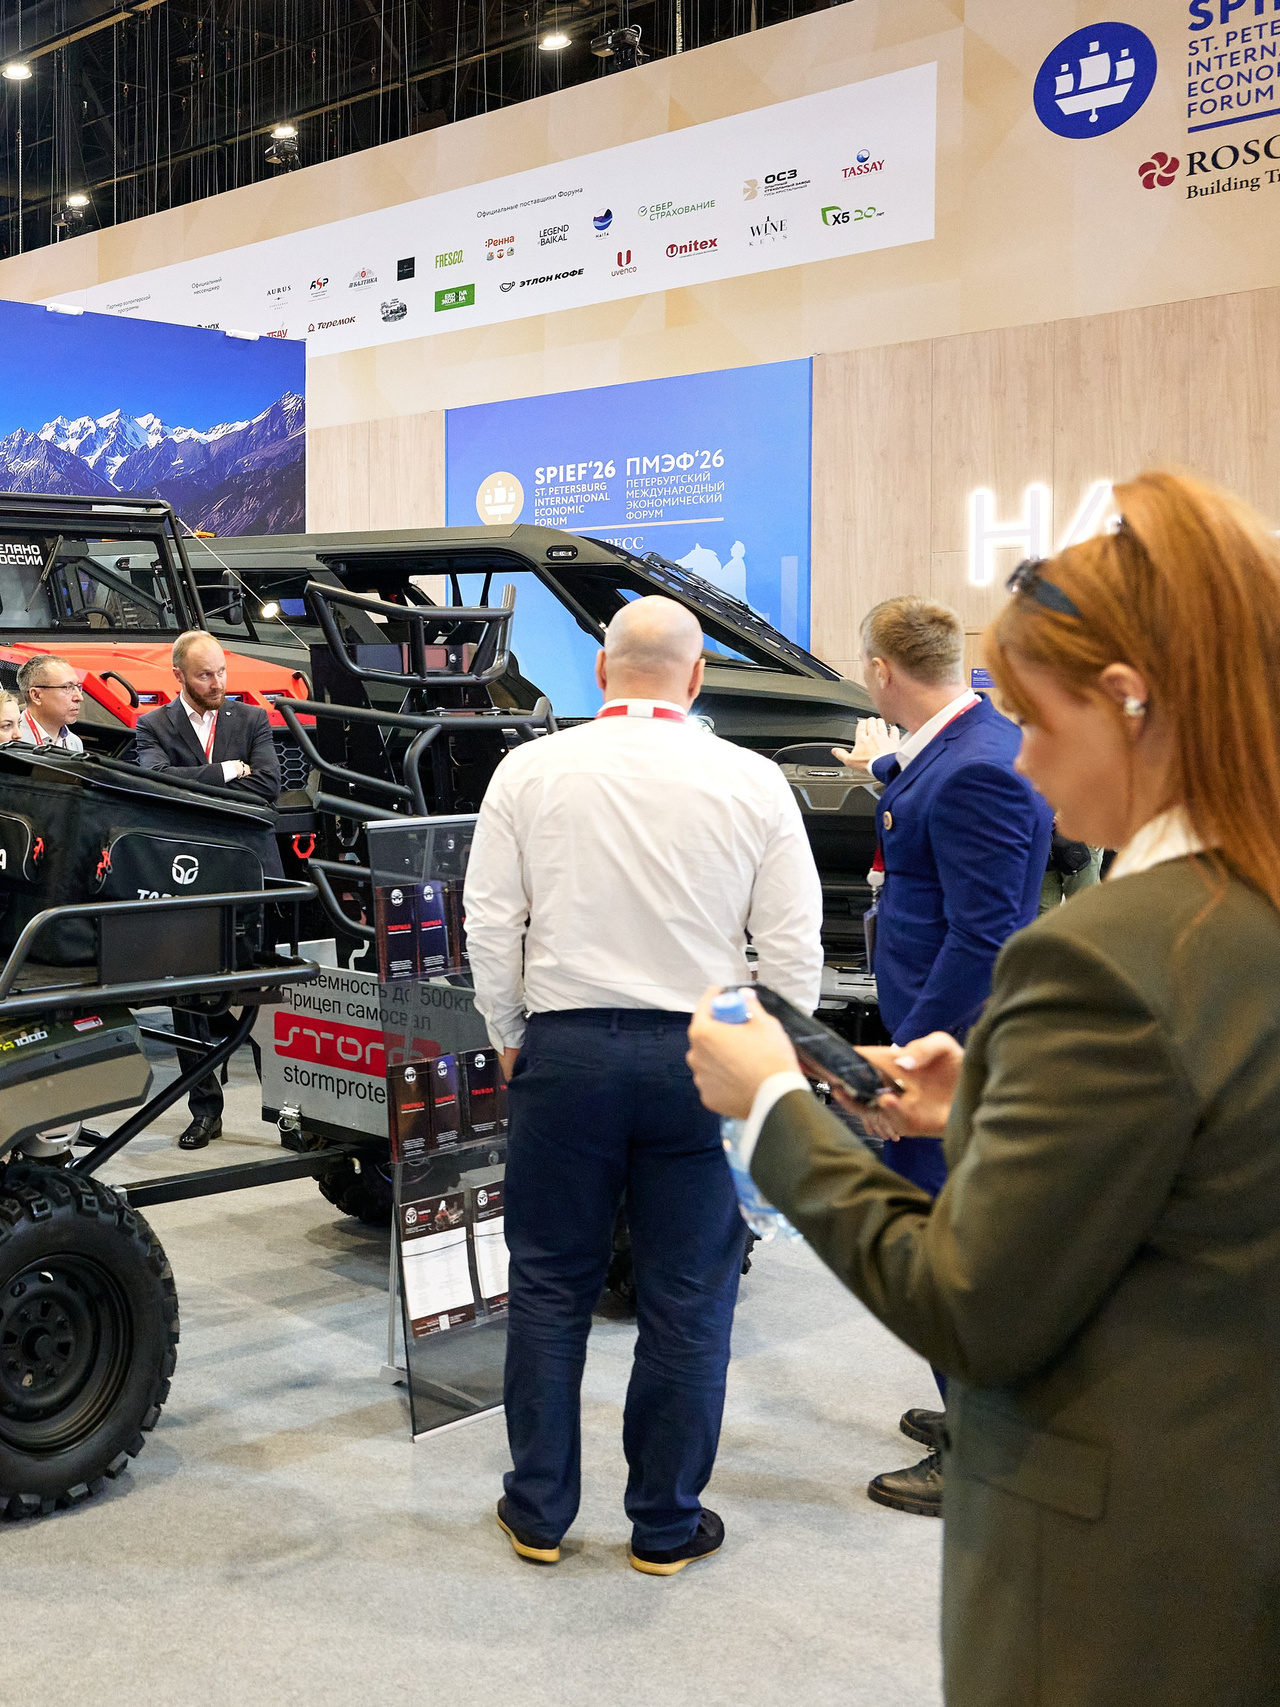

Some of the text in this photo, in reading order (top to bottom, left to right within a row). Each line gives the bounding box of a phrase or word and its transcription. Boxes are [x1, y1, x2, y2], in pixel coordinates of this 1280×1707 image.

[1188, 0, 1280, 31] SPI
[1188, 36, 1218, 56] ST.
[1188, 42, 1280, 77] INTERN
[1188, 62, 1280, 98] ECONO
[1187, 85, 1274, 118] FORUM
[842, 159, 885, 178] TASSAY
[558, 187, 584, 198] Форума
[1186, 177, 1261, 199] Building
[649, 201, 673, 213] СБЕР
[649, 199, 716, 221] СТРАХОВАНИЕ
[750, 216, 788, 238] WINE
[832, 211, 850, 226] X5
[539, 224, 570, 238] LEGEND
[540, 234, 568, 246] BAIKAL
[519, 268, 585, 288] ЭТЛОН КОФЕ
[611, 265, 637, 277] uvenco
[266, 285, 292, 296] AURUS
[317, 316, 356, 330] Теремок
[626, 470, 711, 489] ПЕТЕРБУРГСКИЙ
[534, 481, 607, 497] ST. PETERSBURG
[626, 480, 725, 499] МЕЖДУНАРОДНЫЙ
[534, 492, 611, 507] INTERNATIONAL
[626, 492, 723, 510] ЭКОНОМИЧЕСКИЙ
[534, 505, 585, 517] ECONOMIC
[626, 508, 663, 520] ФОРУМ
[534, 515, 568, 527] FORUM
[282, 987, 341, 1015] Прицеп
